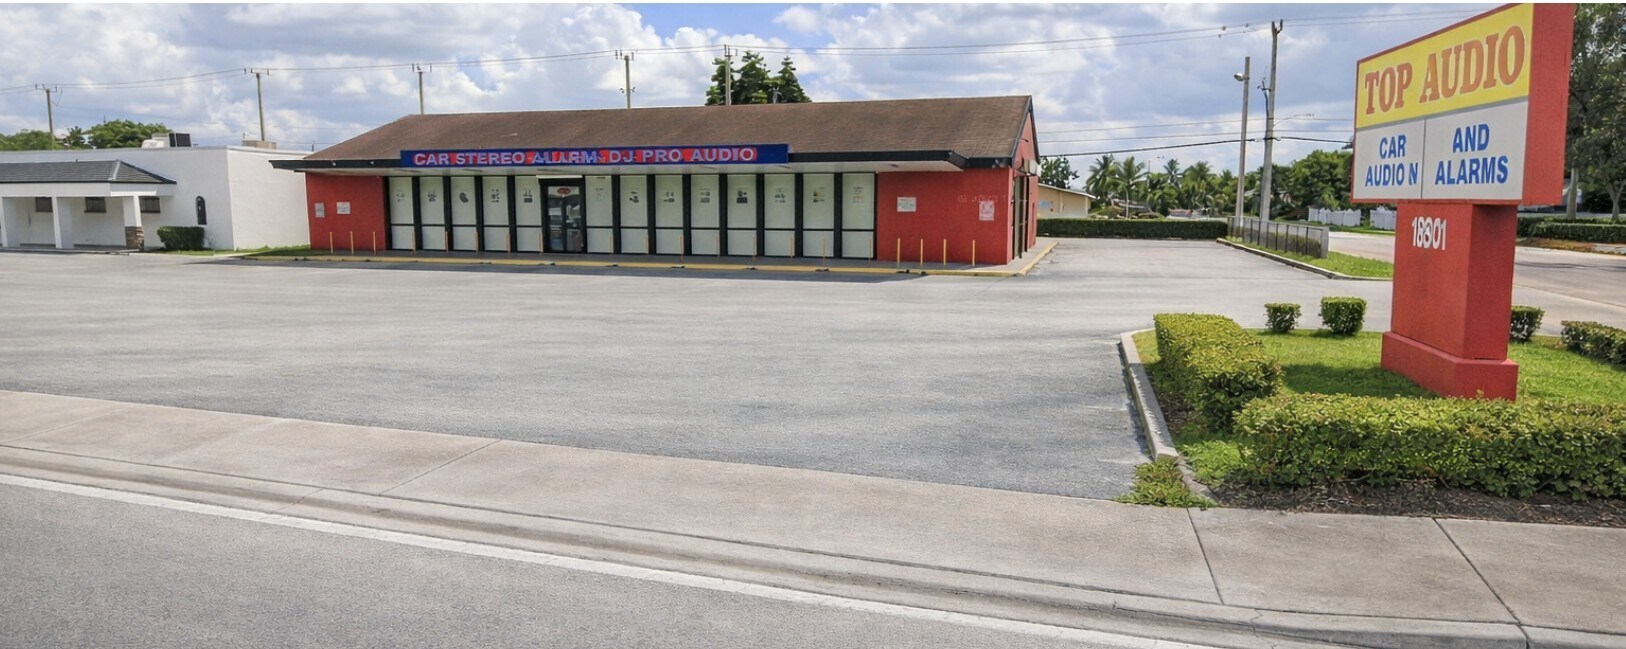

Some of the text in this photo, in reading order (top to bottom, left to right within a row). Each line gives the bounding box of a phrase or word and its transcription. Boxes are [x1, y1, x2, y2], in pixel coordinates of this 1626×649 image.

[1365, 25, 1525, 115] TOP AUDIO
[1379, 134, 1407, 159] CAR
[1452, 123, 1490, 153] AND
[414, 153, 449, 166] CAR
[456, 151, 526, 165] STEREO
[642, 149, 682, 163] PRO
[690, 147, 755, 162] AUDIO
[1435, 155, 1509, 185] ALARMS
[1365, 162, 1419, 187] AUDIO N
